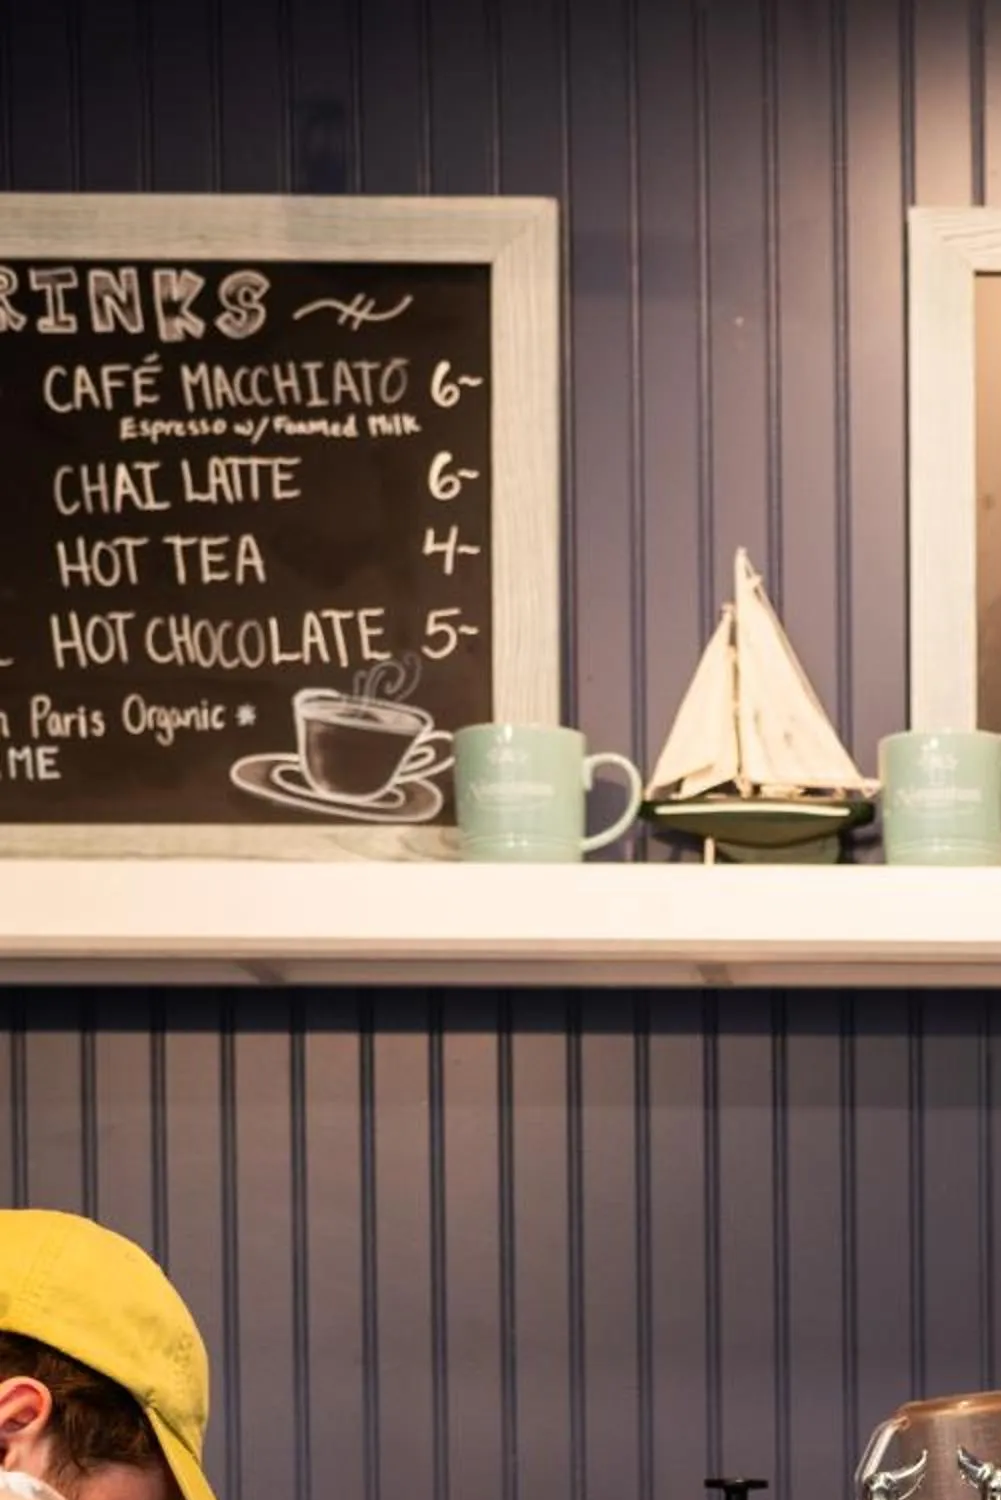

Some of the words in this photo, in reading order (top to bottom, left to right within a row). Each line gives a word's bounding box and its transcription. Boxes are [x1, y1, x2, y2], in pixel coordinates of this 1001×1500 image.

[43, 353, 162, 412] CAFÉ
[180, 358, 409, 412] MACCHIATO
[119, 416, 227, 445] Espresso
[367, 413, 421, 437] Milk
[54, 461, 171, 515] CHAI
[183, 456, 301, 502] LATTE
[57, 535, 149, 588] HOT
[164, 534, 266, 586] TEA
[51, 610, 135, 669] HOT
[145, 608, 393, 668] CHOCOLATE
[30, 694, 105, 739] Paris
[122, 693, 226, 746] Organic
[0, 745, 61, 780] ME
